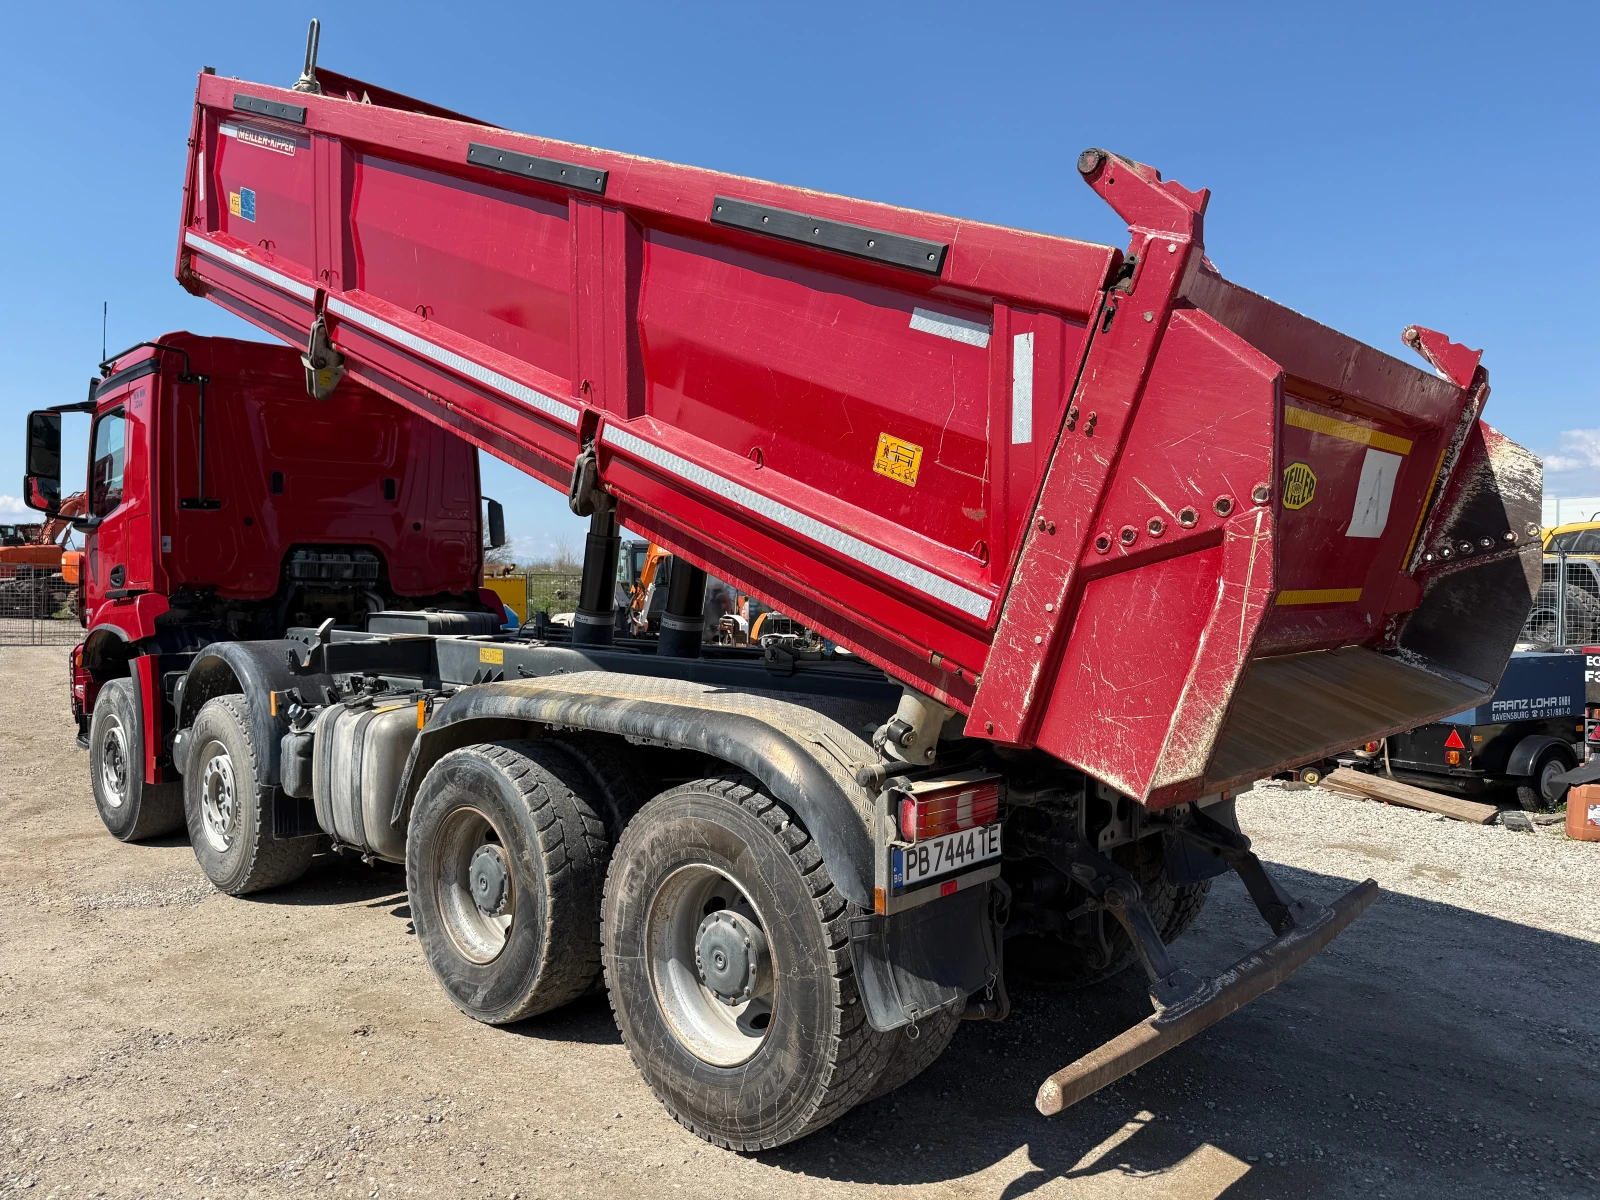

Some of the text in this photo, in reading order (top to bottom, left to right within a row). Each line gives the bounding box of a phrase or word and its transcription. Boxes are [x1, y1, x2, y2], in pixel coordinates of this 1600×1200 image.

[1492, 699, 1528, 712] FRANZ
[1530, 696, 1557, 709] LOHR
[1492, 710, 1529, 722] RAVENSBURG
[906, 826, 999, 880] PB 7444 TE
[894, 873, 903, 884] BG
